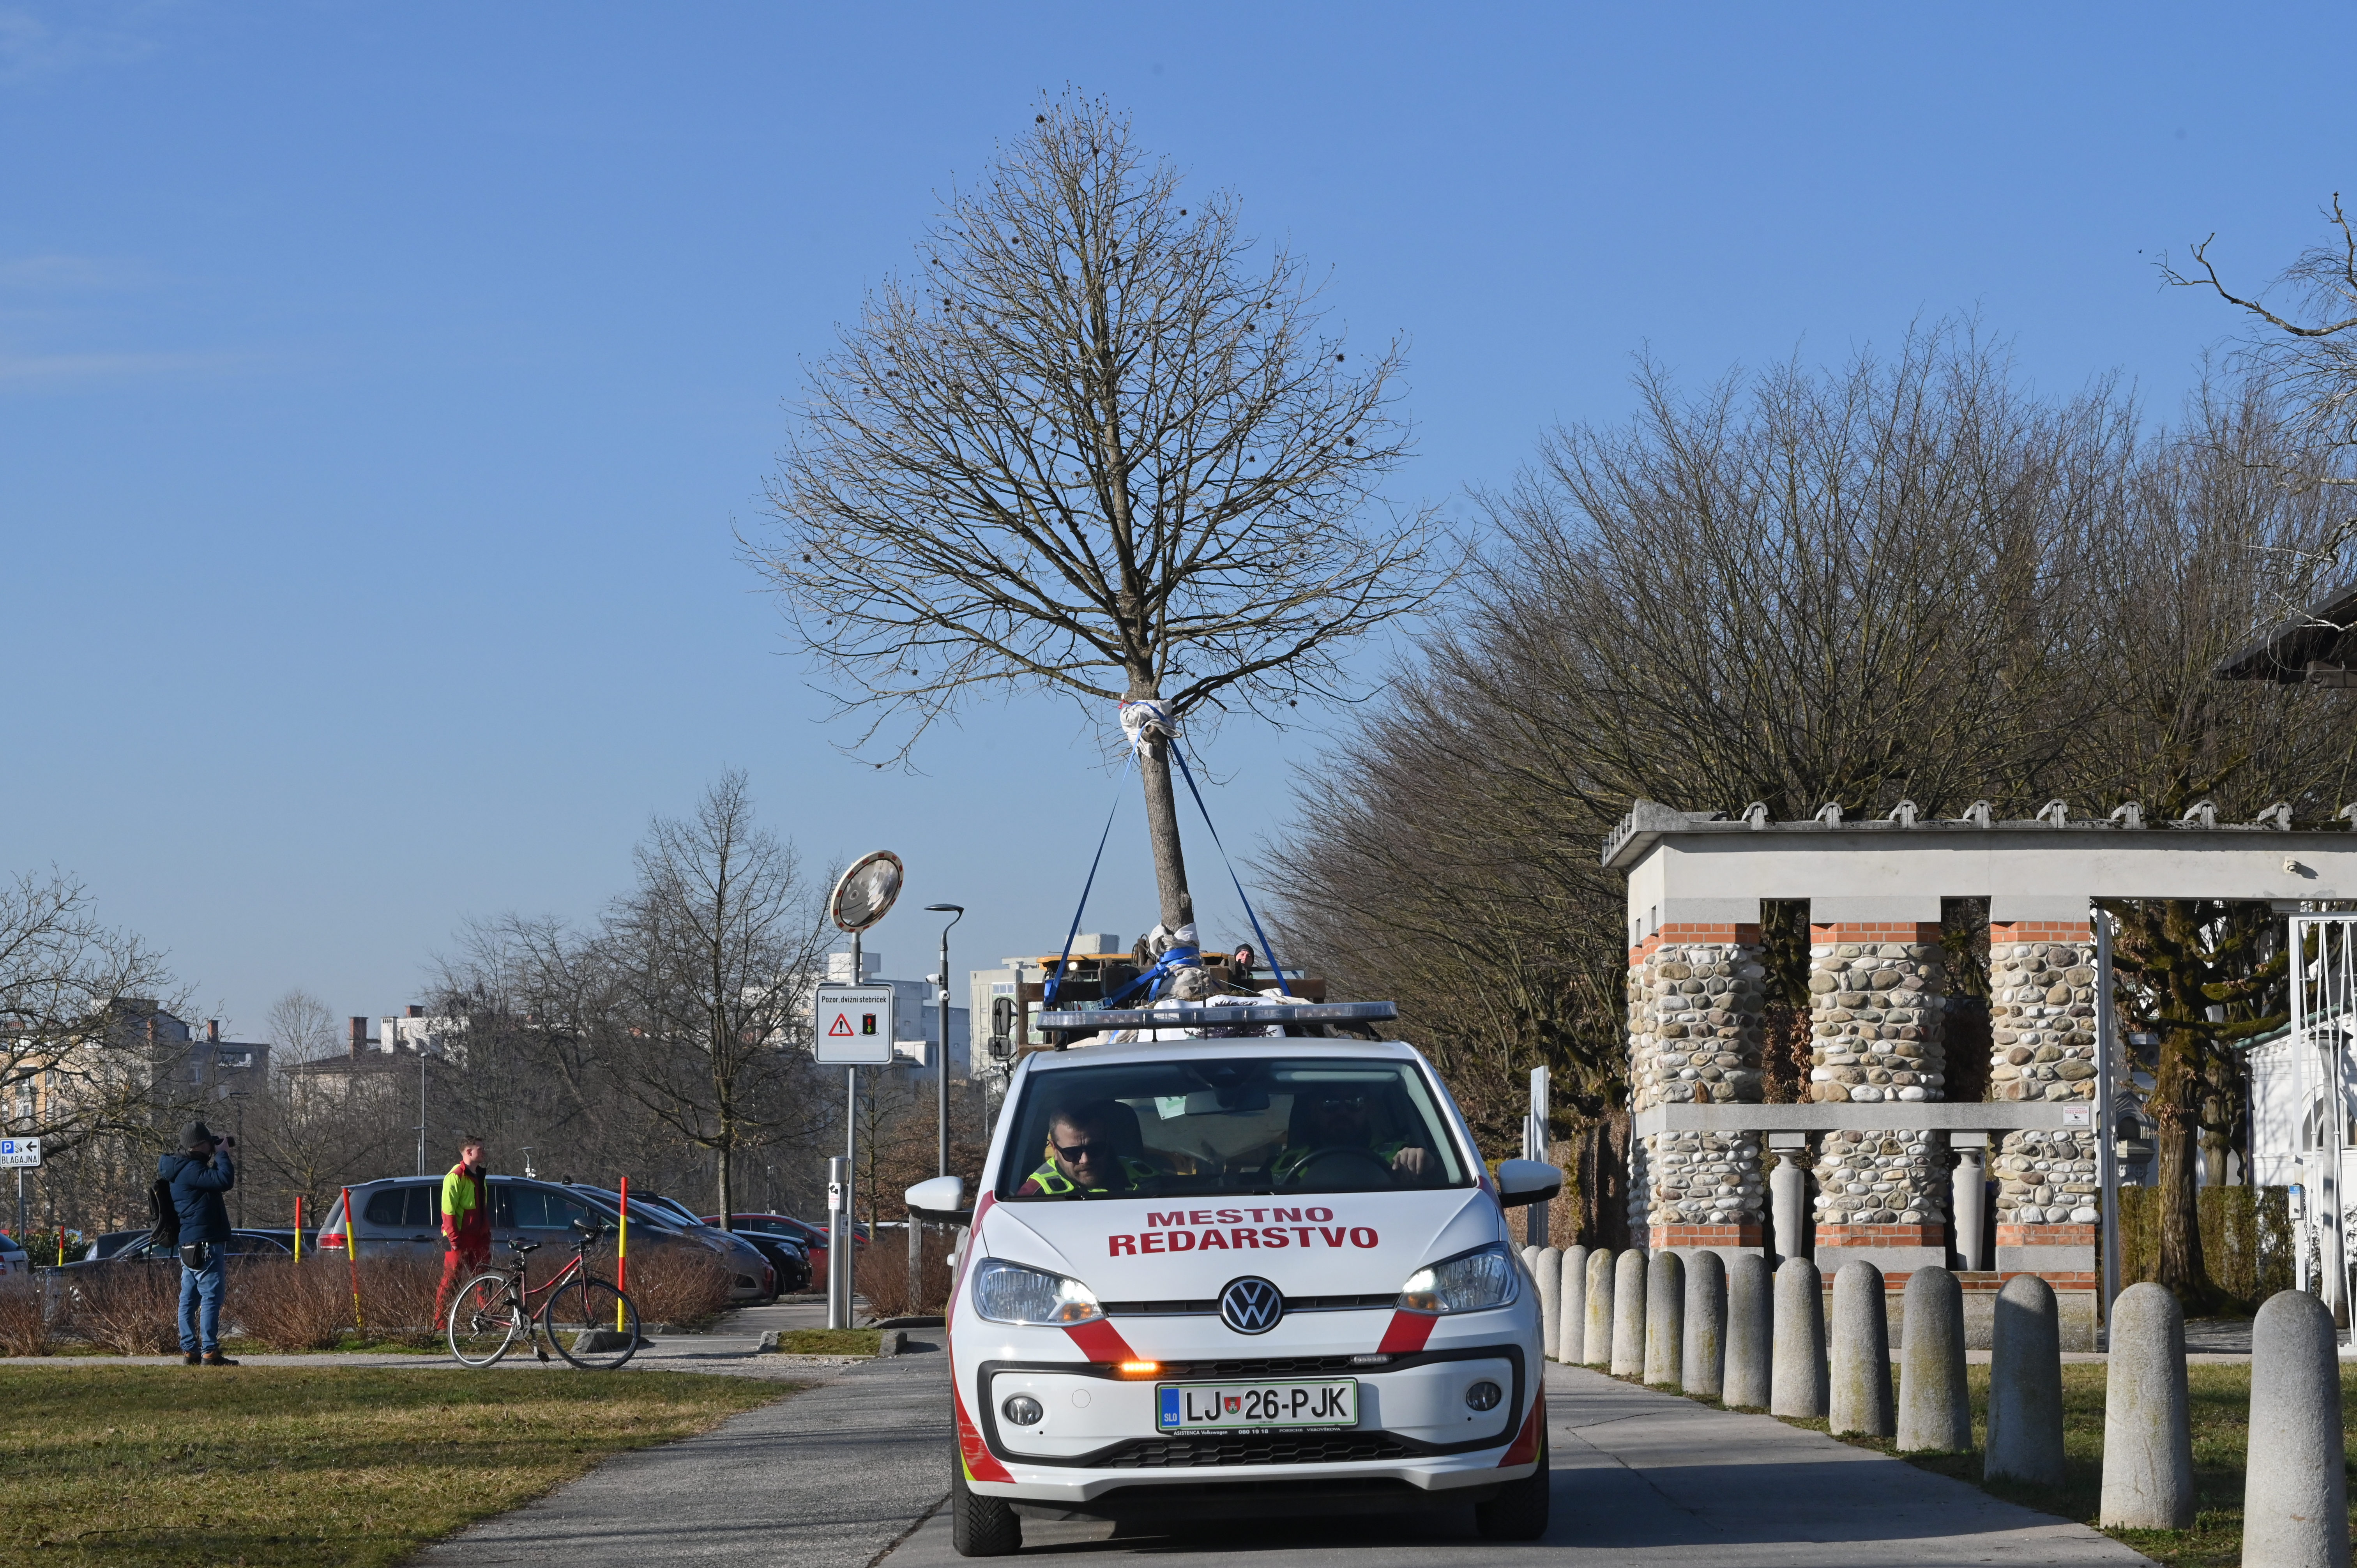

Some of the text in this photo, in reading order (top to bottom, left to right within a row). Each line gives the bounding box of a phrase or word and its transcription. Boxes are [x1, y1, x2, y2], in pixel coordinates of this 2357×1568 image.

[4, 1142, 11, 1153] P
[2, 1155, 37, 1164] BLAGAJNA
[1147, 1207, 1334, 1227] MESTNO
[1108, 1227, 1378, 1257] REDARSTVO
[1186, 1388, 1347, 1421] LJ 26-PJK
[1164, 1413, 1177, 1422] SLO
